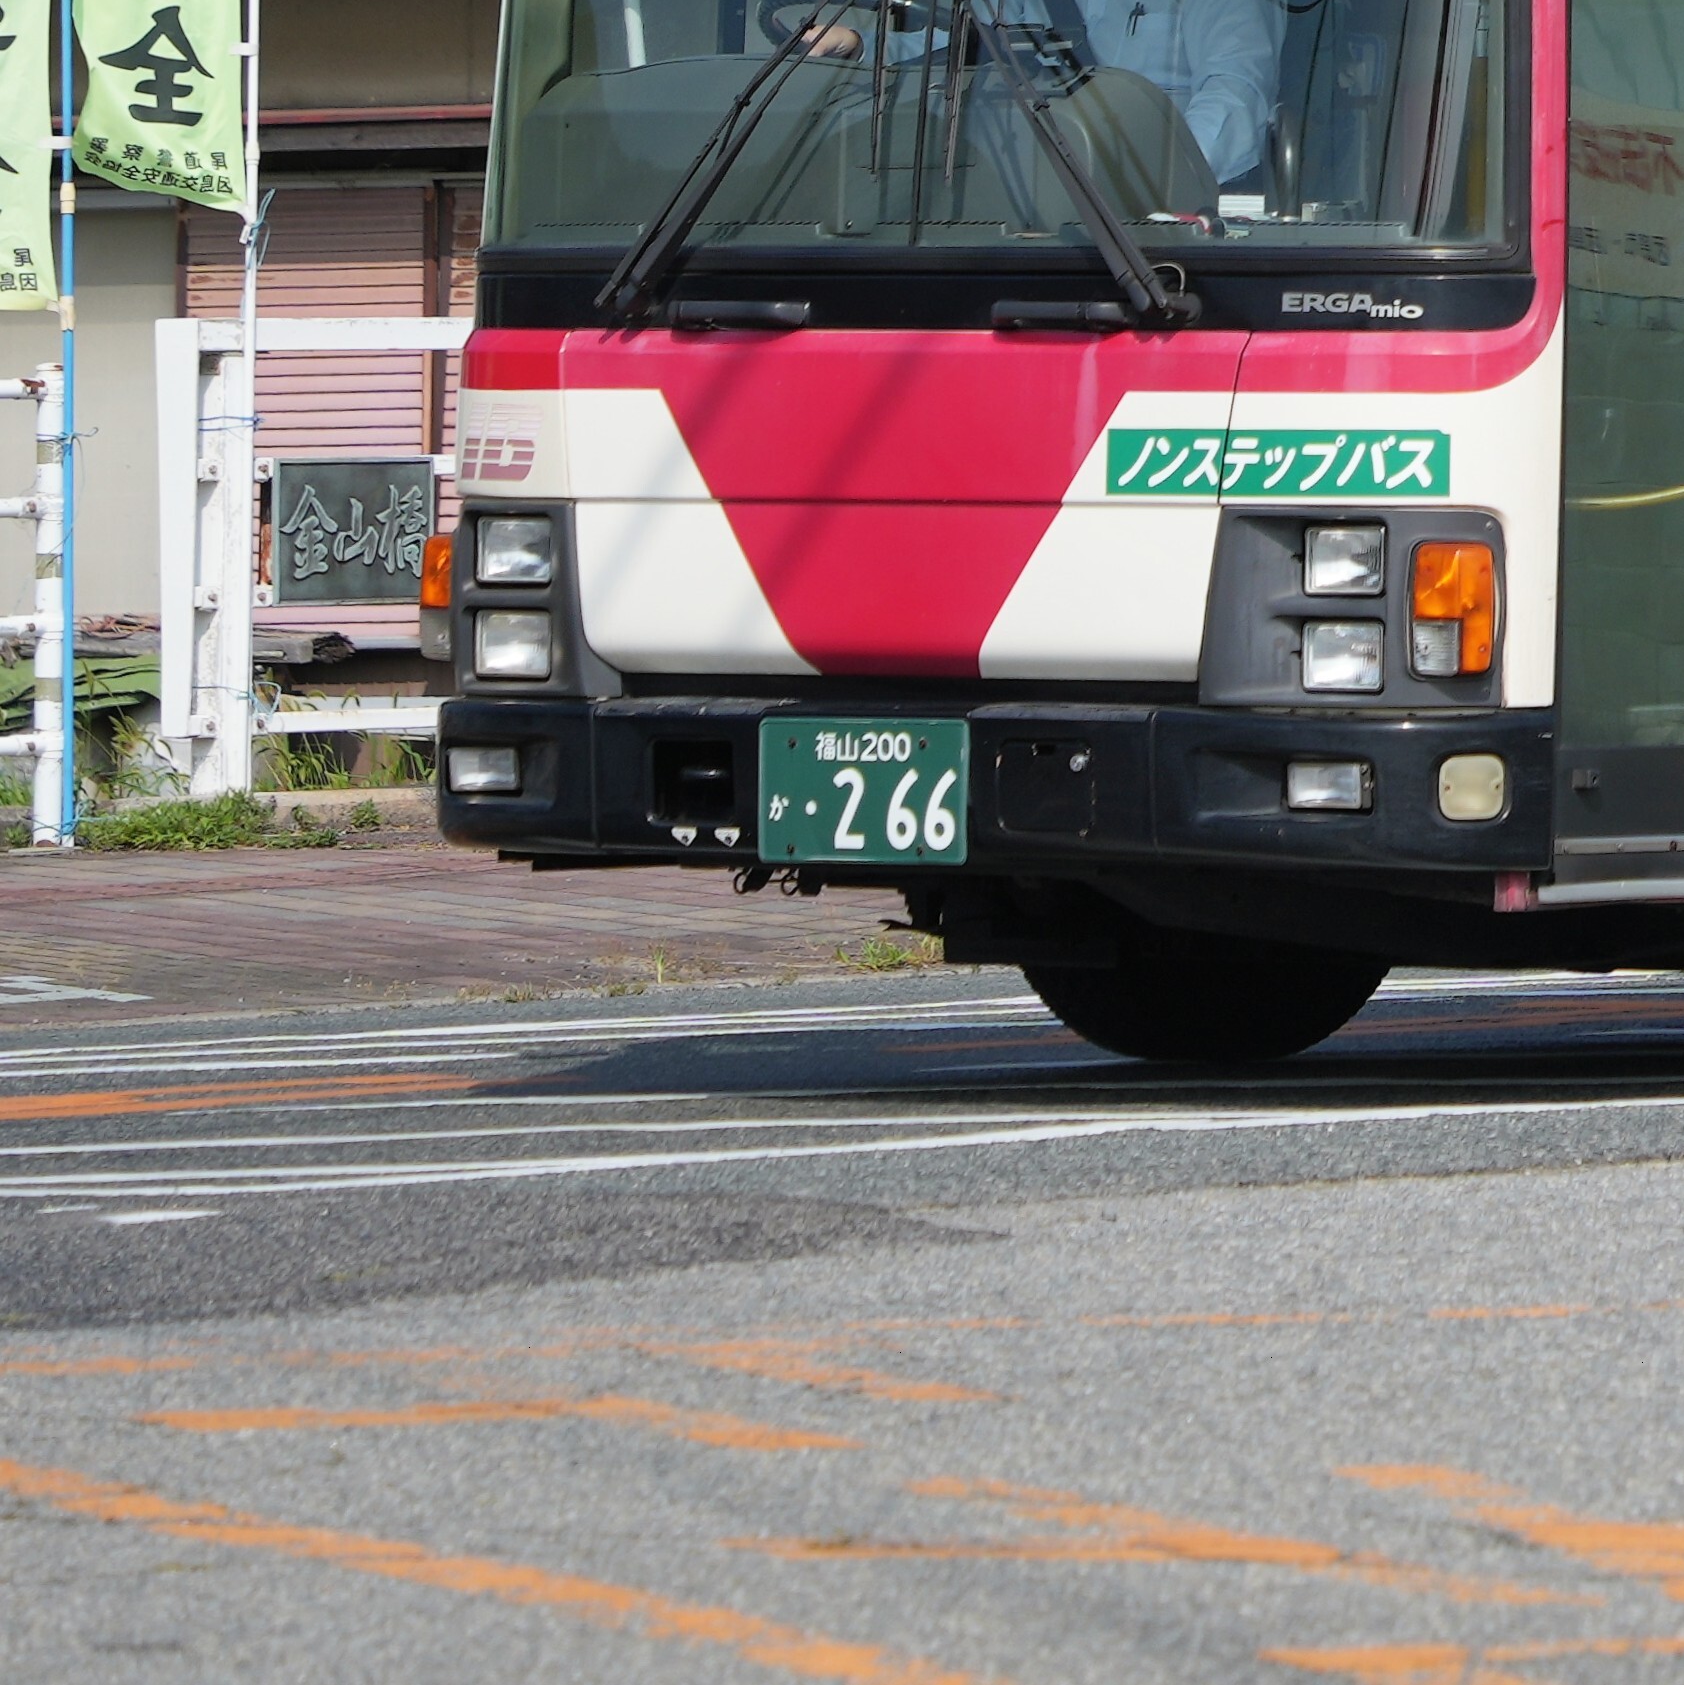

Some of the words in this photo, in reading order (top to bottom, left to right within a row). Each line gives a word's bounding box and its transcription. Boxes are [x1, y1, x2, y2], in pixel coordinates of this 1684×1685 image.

[1117, 434, 1438, 491] ノンステップバス
[279, 483, 428, 581] 金山橋
[767, 793, 790, 821] か
